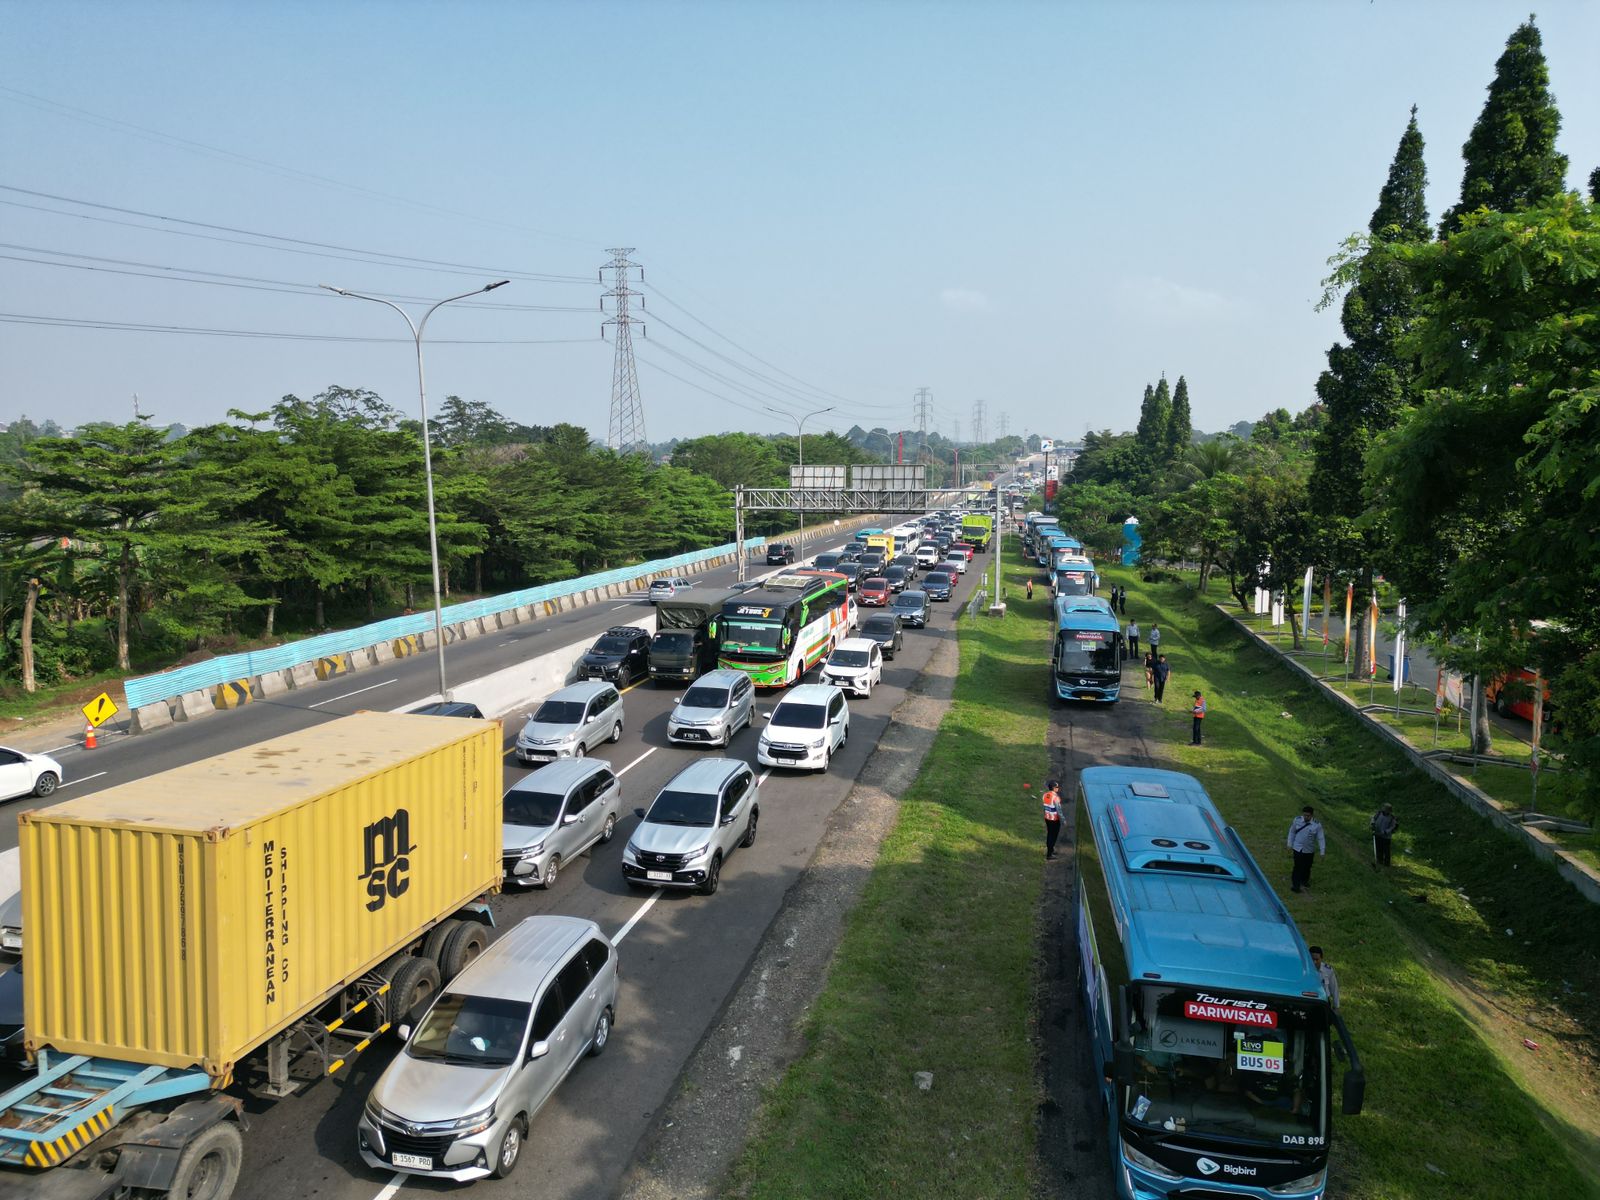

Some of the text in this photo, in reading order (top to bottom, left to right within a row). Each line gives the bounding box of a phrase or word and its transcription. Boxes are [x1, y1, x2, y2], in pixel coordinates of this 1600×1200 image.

[280, 847, 289, 982] SHIPPING CO
[263, 840, 275, 1005] MEDITERRANEAN
[1196, 992, 1267, 1010] Tourista
[1189, 1004, 1273, 1025] PARIWISATA
[1180, 1037, 1217, 1047] LAKSANA
[1242, 1041, 1262, 1049] REVO
[1240, 1056, 1280, 1070] BUS 05
[1282, 1135, 1305, 1145] DAB
[1223, 1164, 1257, 1176] Bigbird
